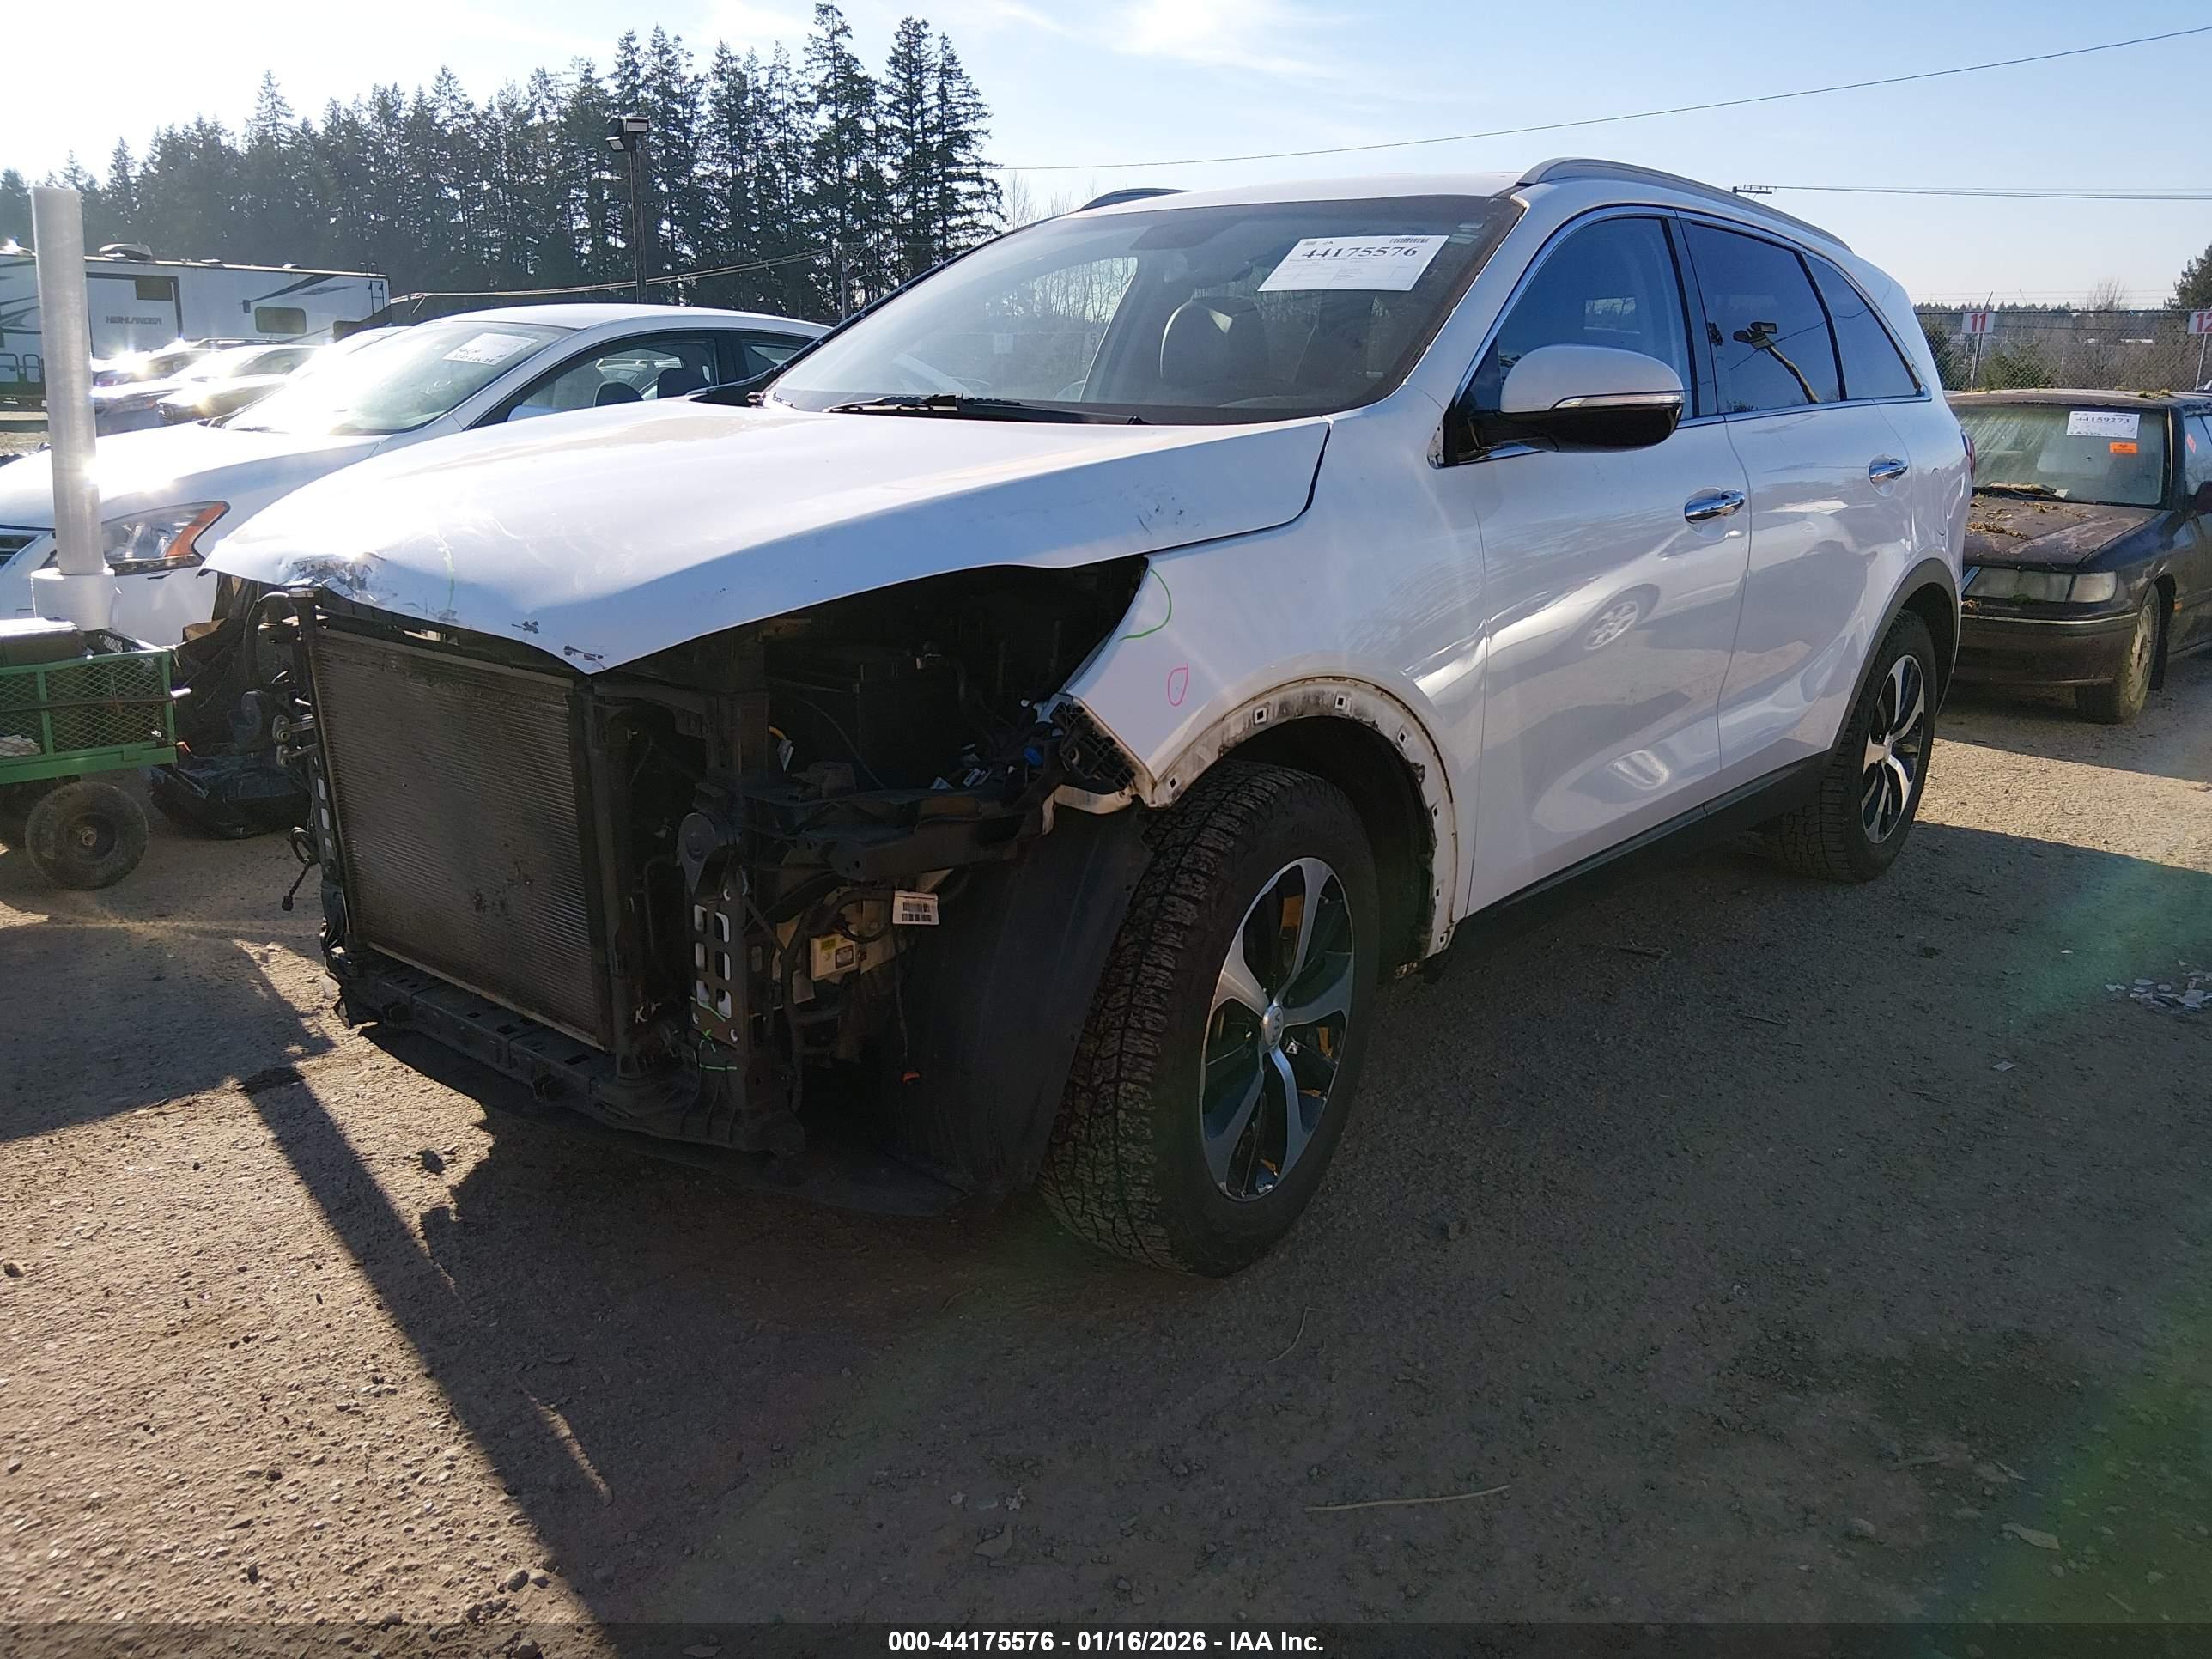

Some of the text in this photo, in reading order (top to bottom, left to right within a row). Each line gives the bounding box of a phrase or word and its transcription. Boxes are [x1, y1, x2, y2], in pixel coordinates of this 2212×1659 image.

[1302, 246, 1419, 258] 44175576
[106, 315, 162, 325] HIGHLANDER
[1971, 313, 1986, 332] 11
